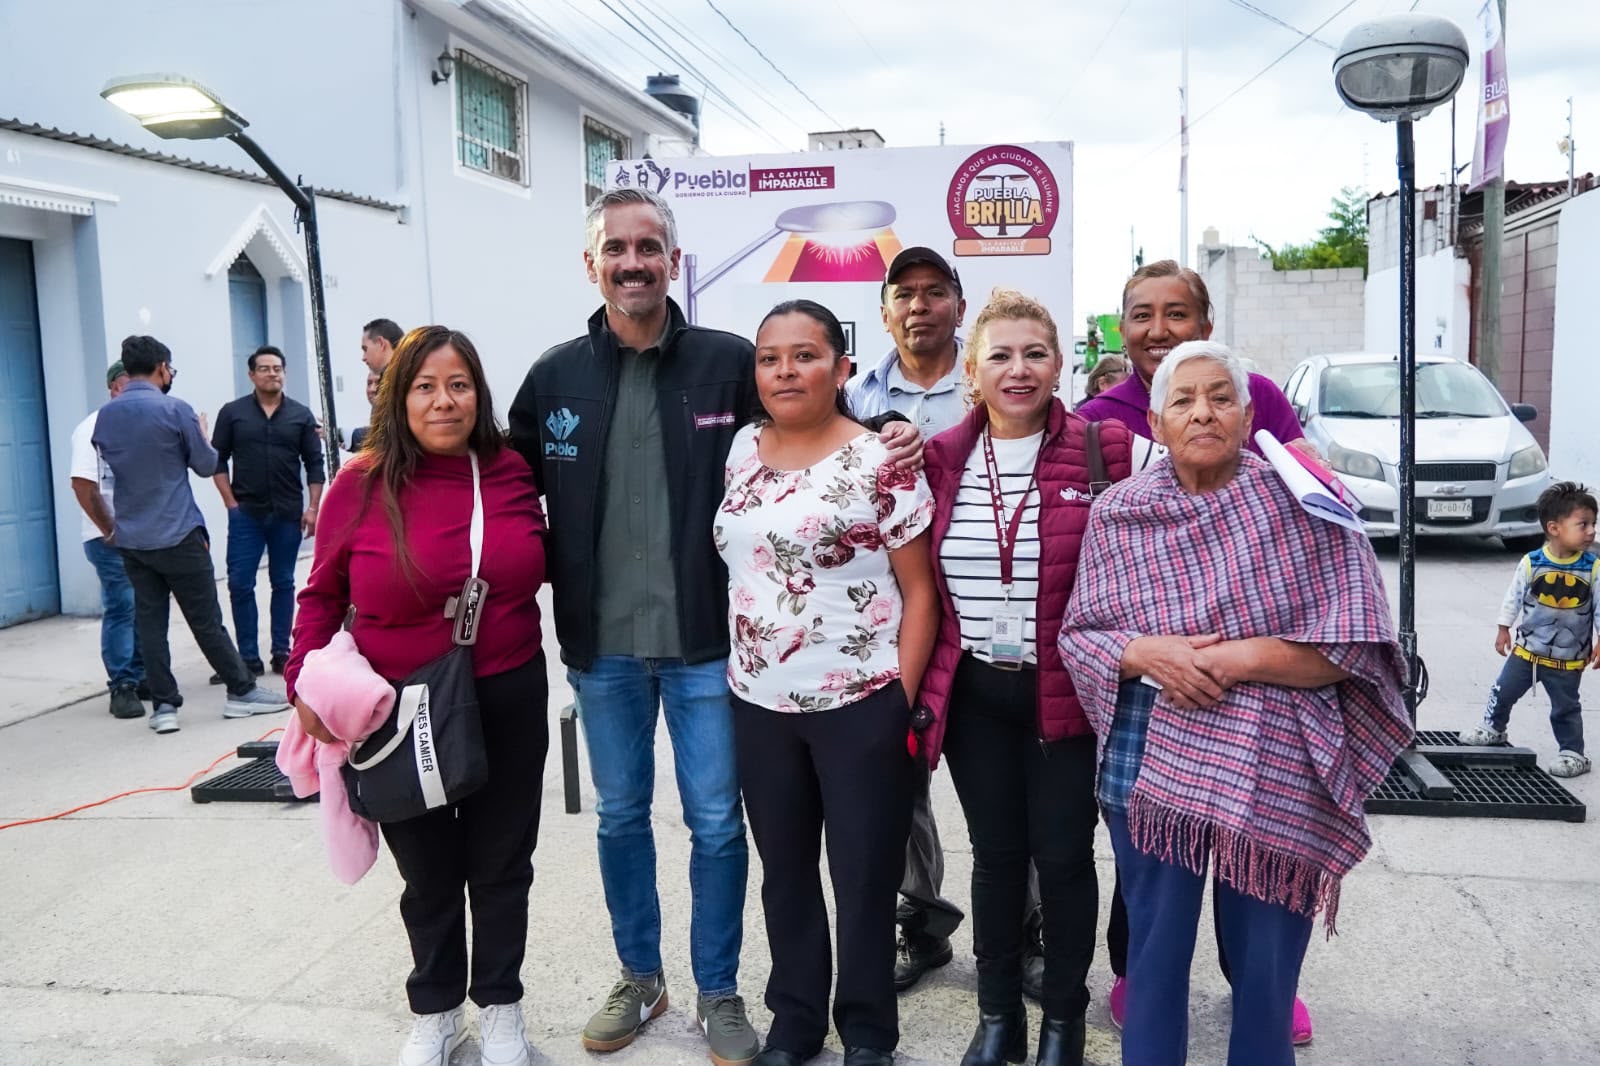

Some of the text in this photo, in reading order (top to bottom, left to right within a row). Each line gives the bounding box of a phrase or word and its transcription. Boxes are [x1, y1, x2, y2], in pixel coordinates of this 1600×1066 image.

[674, 170, 747, 190] Puebla
[758, 177, 828, 189] IMPARABLE
[778, 170, 822, 178] CAPITAL
[953, 152, 1053, 216] HAGAMOS QUE LA CIUDAD SE ILUMINE
[973, 187, 1031, 200] PUEBLA
[964, 200, 1045, 226] BRILLA
[418, 703, 433, 773] EVES CAMIER
